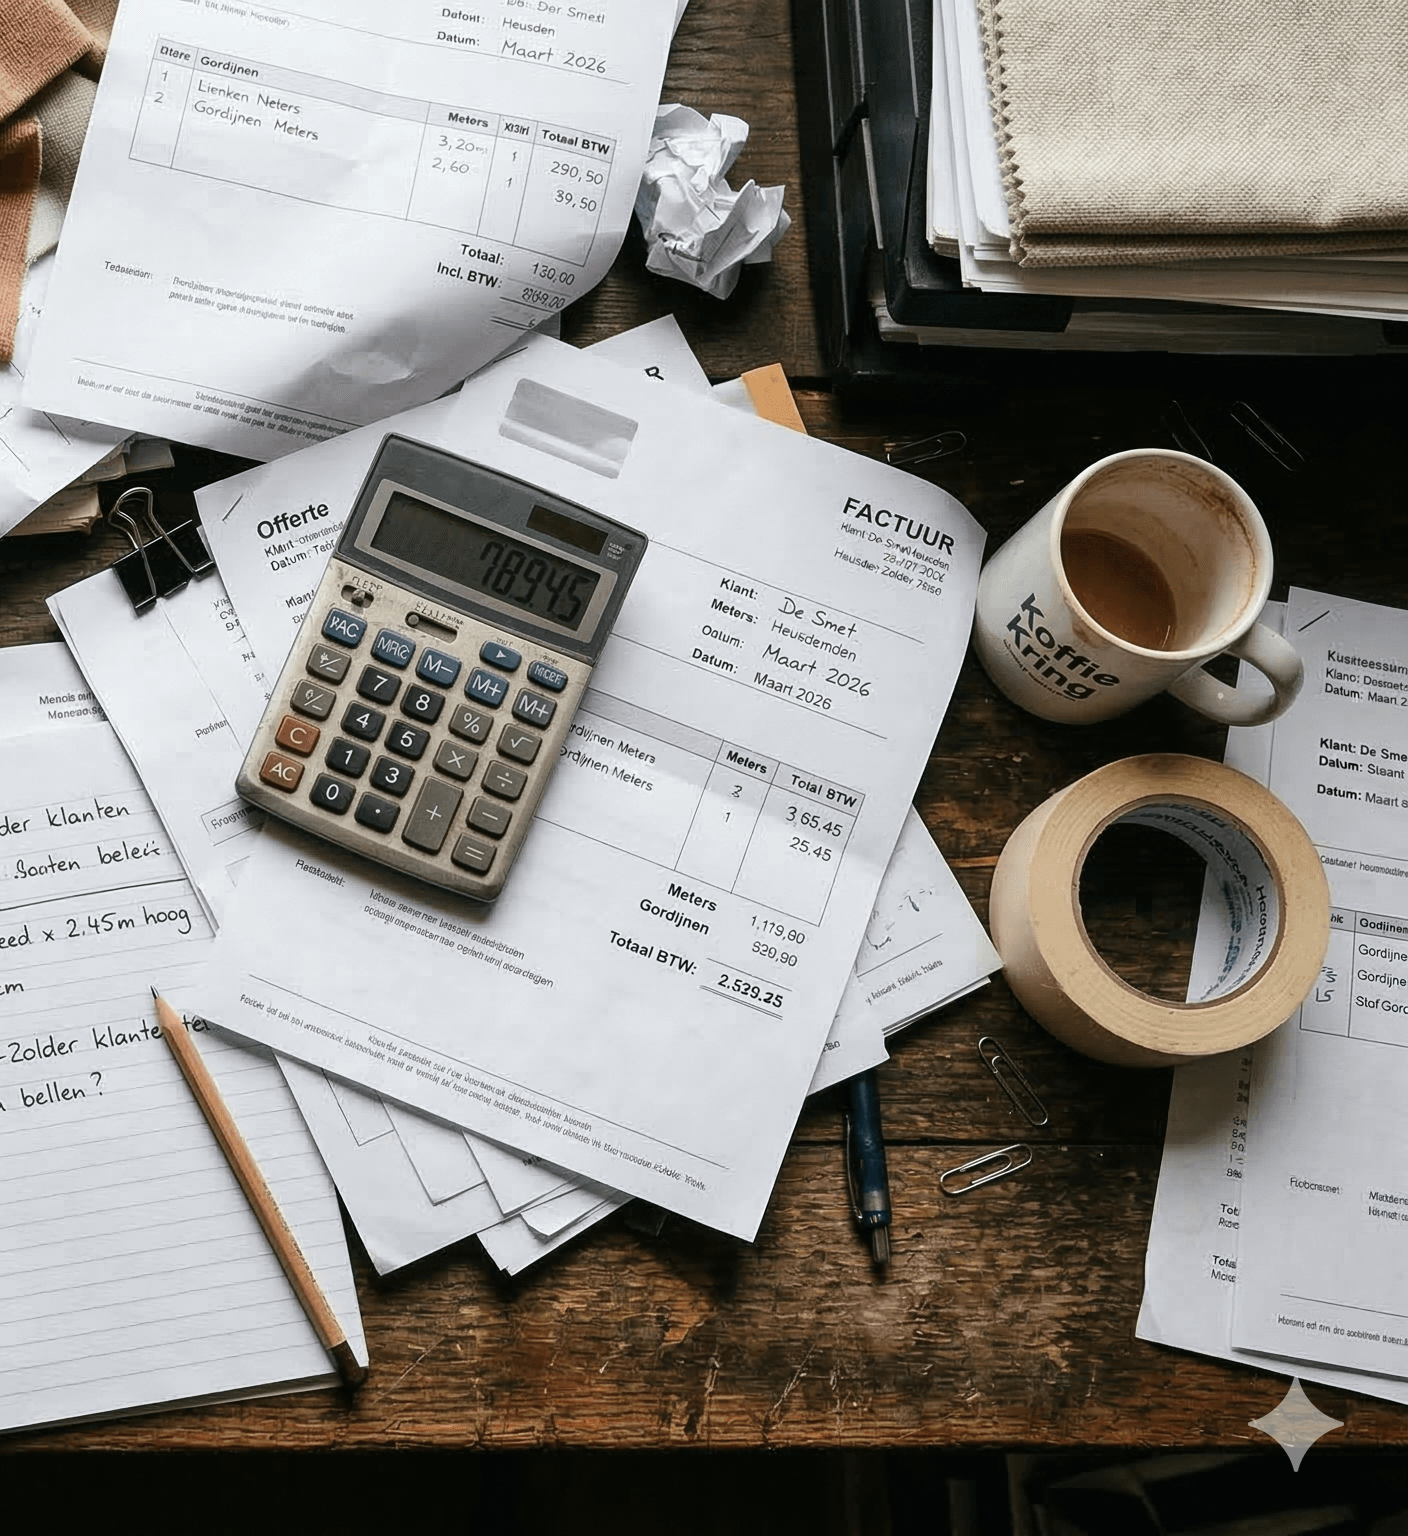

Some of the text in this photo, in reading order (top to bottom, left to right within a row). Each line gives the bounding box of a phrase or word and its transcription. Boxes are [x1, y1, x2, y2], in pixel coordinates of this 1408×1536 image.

[502, 17, 556, 37] Heusden
[437, 31, 607, 74] Datum: Maart 2026
[154, 92, 164, 103] 2
[194, 100, 262, 127] Gordijnen
[200, 56, 259, 78] Gordijnen
[581, 139, 610, 155] BTW
[461, 243, 505, 266] Totaal:
[437, 262, 503, 289] Incl. BTW:
[257, 503, 329, 539] Offerte
[842, 496, 955, 556] FACTUUR
[777, 597, 804, 619] De
[811, 611, 857, 638] Smet
[1006, 613, 1097, 699] Kring
[1020, 592, 1120, 687] Koffie
[692, 647, 739, 674] Datum:
[796, 688, 832, 710] 2026
[762, 644, 817, 675] Maart
[825, 668, 872, 697] 2026
[373, 675, 388, 691] 7
[415, 694, 431, 711] 8
[1325, 683, 1363, 700] Datum:
[356, 713, 416, 747] 4 5
[1320, 737, 1356, 754] Klant:
[1360, 744, 1377, 757] De
[289, 727, 400, 784] C 1 3
[269, 762, 340, 800] AC 0
[726, 750, 768, 774] Meters
[826, 788, 858, 808] BTW
[1316, 784, 1362, 801] Datum:
[45, 798, 130, 827] klanten
[668, 883, 718, 912] Meters
[42, 929, 55, 943] x
[66, 912, 135, 938] 2.45m
[142, 906, 192, 935] hoog
[610, 930, 654, 958] Totaal
[656, 949, 698, 975] BTW:
